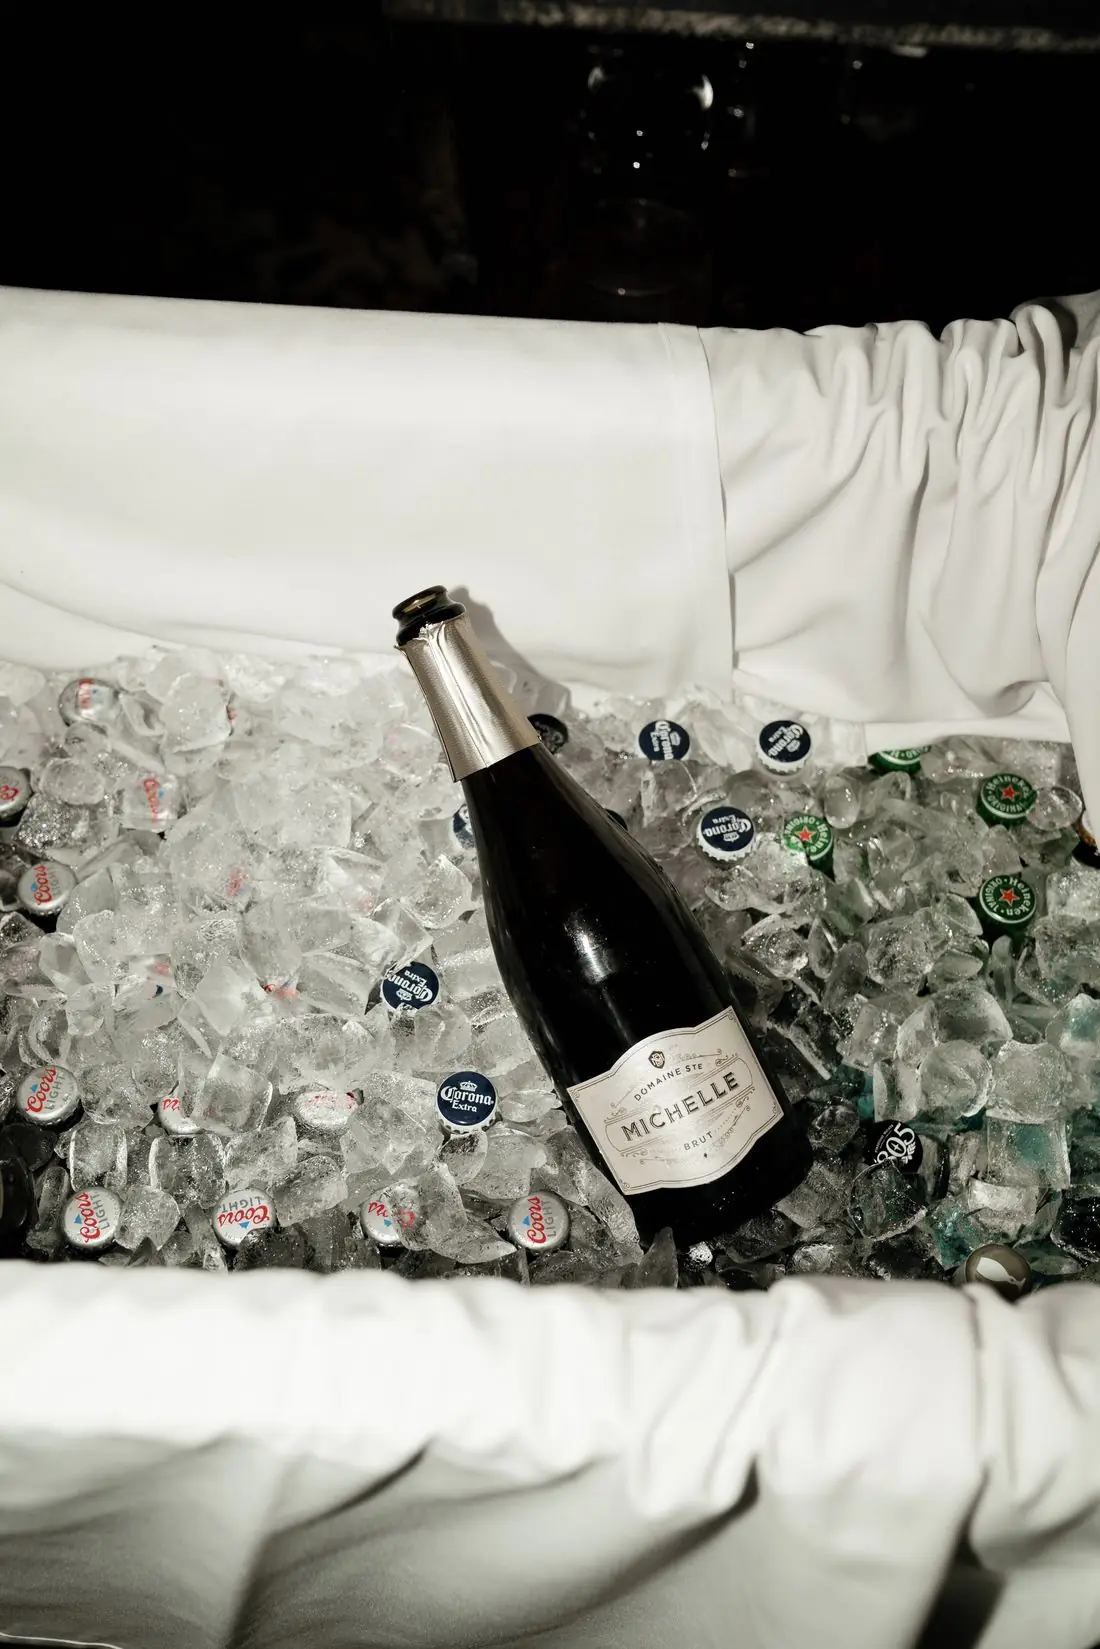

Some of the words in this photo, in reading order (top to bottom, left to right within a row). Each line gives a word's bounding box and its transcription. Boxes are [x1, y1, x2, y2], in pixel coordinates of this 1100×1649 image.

[768, 724, 804, 757] Corona
[703, 817, 752, 837] Corona
[33, 865, 52, 905] Coors
[984, 877, 1003, 912] ORIGINAL
[1005, 877, 1031, 916] Heineken
[404, 970, 428, 987] Extra
[24, 1067, 57, 1113] Coors
[440, 1085, 494, 1106] Corona
[633, 1068, 682, 1102] DOMAINE
[452, 1100, 478, 1112] Extra
[621, 1071, 740, 1142] MICHELLE
[683, 1130, 713, 1151] BRUT
[75, 1192, 100, 1243] Coors
[90, 1193, 110, 1230] LIGHT
[217, 1205, 270, 1227] Coors
[222, 1196, 262, 1213] LIGHT
[527, 1196, 547, 1243] Coors
